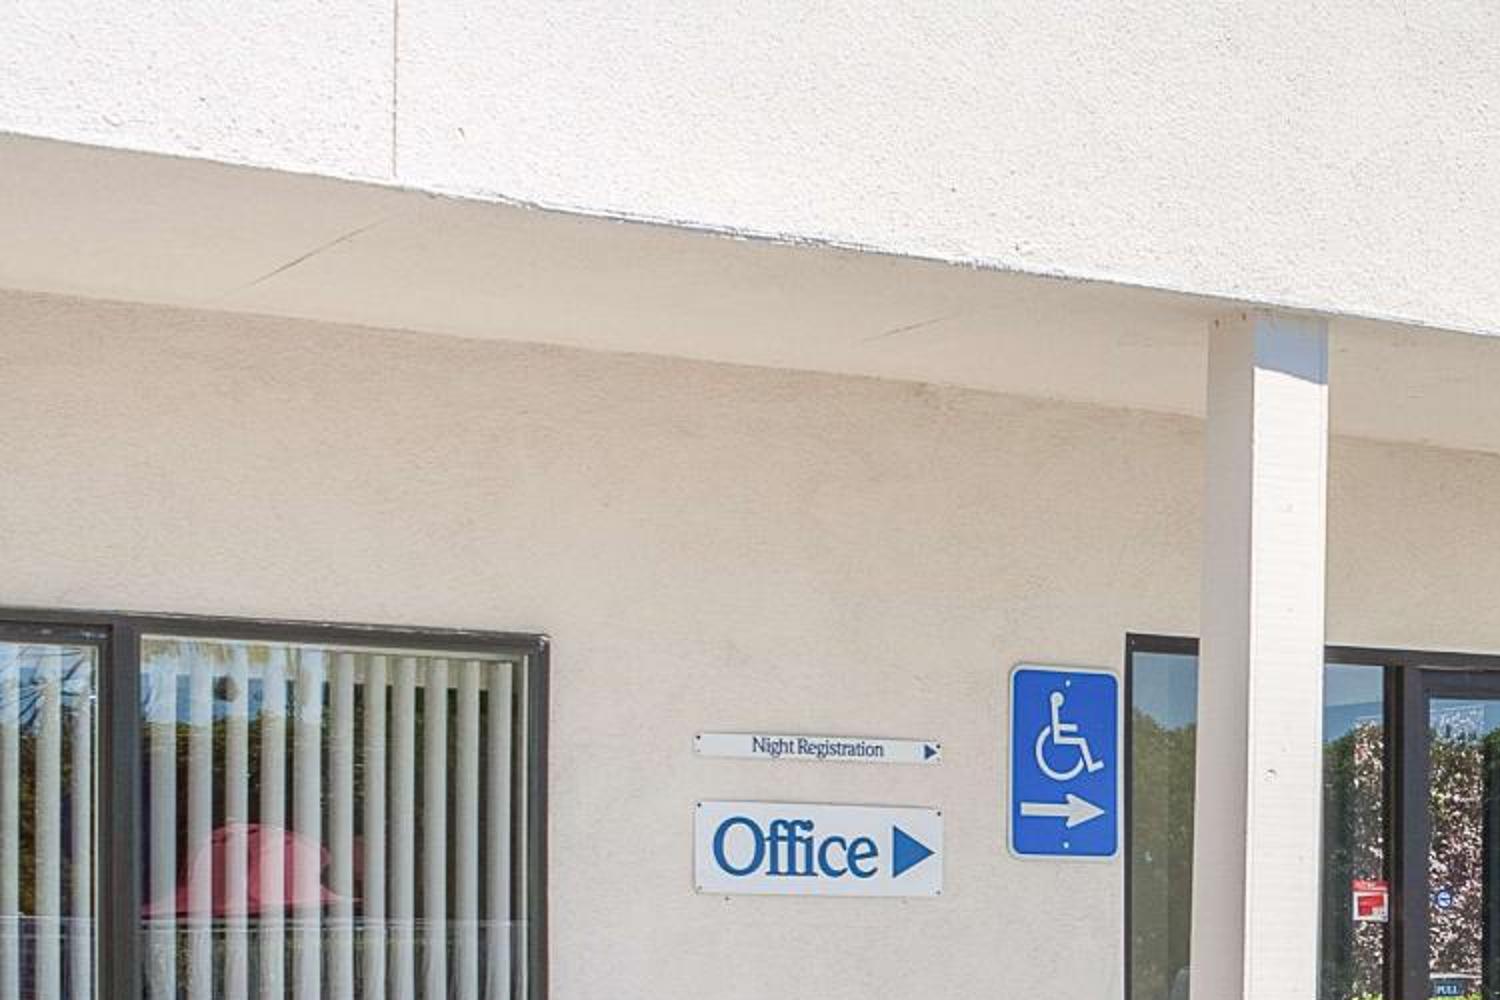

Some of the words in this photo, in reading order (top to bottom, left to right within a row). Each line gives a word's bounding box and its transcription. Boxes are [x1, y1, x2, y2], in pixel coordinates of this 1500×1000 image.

[752, 736, 796, 758] Night
[797, 738, 884, 759] Registration
[712, 815, 879, 879] Office
